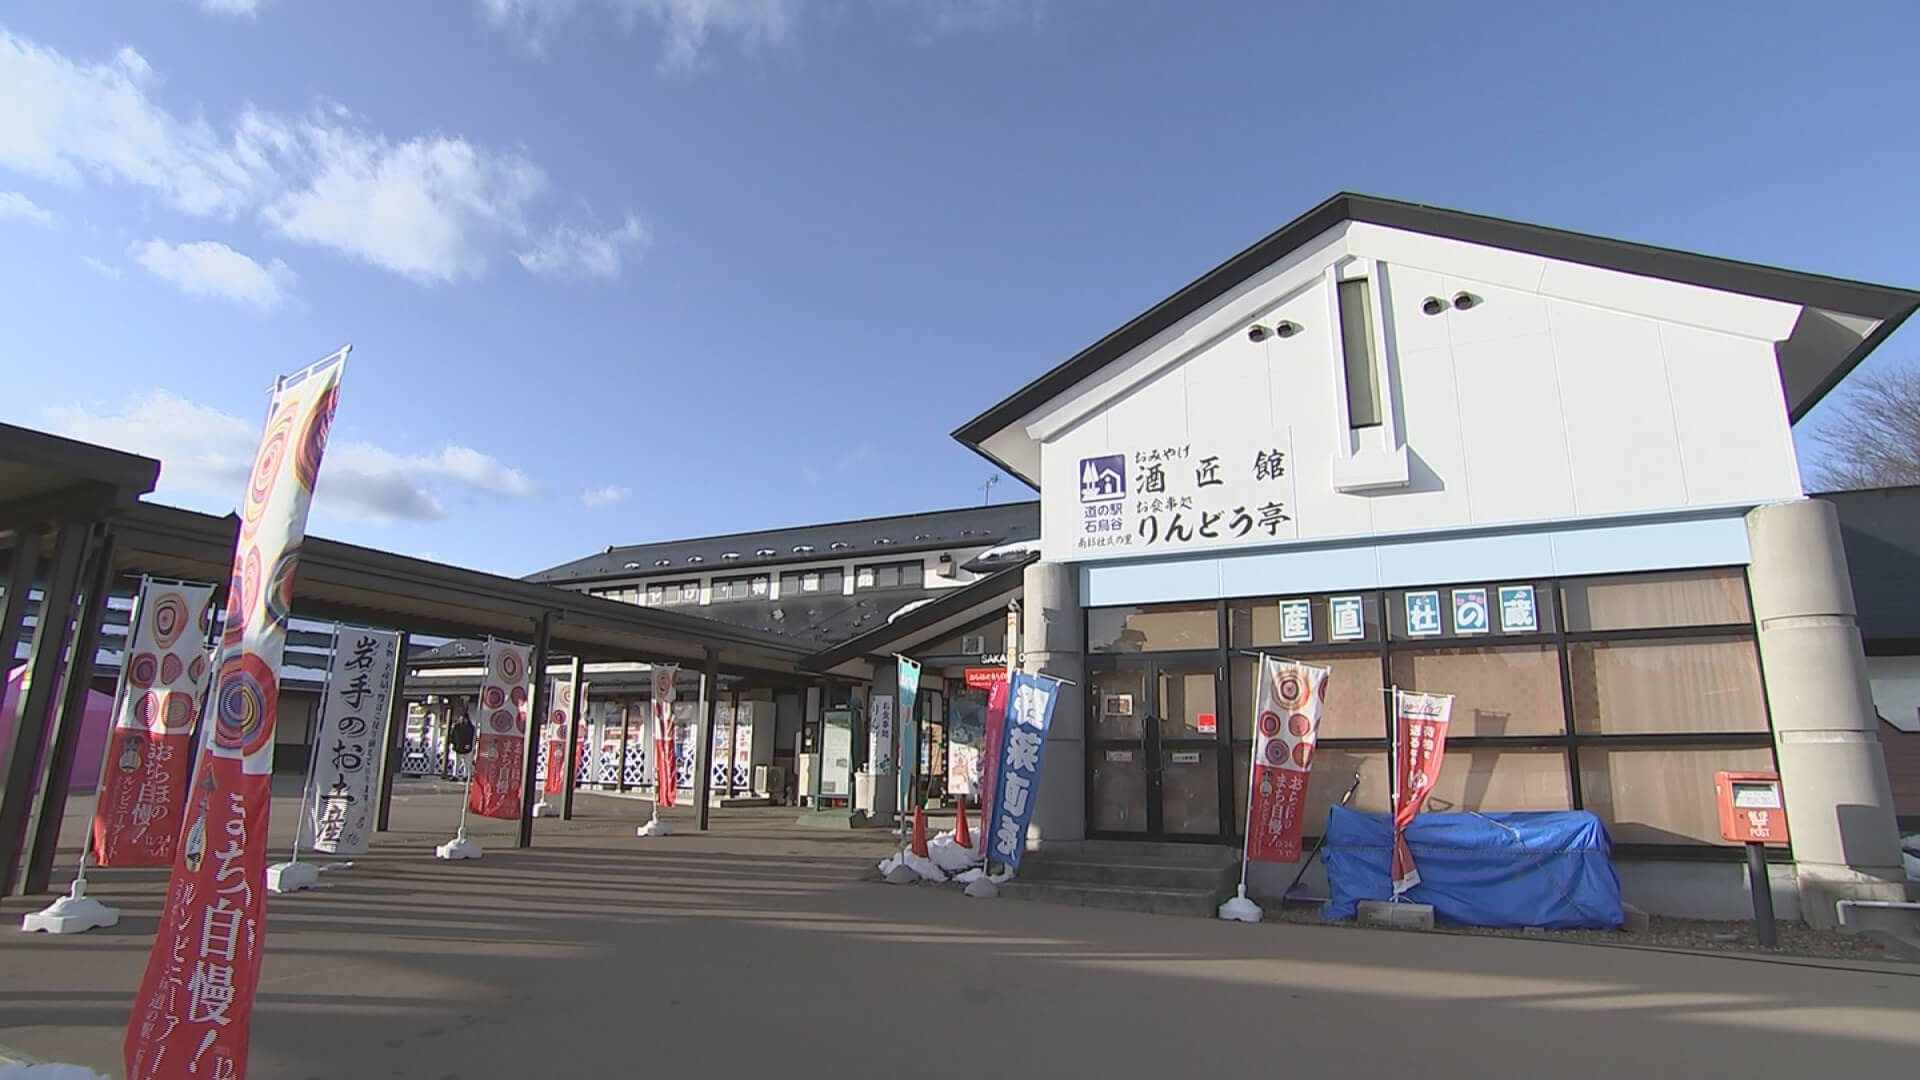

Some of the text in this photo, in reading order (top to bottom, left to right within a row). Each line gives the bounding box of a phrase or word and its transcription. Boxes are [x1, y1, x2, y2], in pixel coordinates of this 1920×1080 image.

[1134, 443, 1191, 464] おみやげ
[1135, 449, 1287, 495] 酒匠館
[1084, 502, 1123, 518] 道の駅
[1136, 496, 1193, 514] お食事処
[1084, 518, 1123, 533] 石鳥谷
[1138, 501, 1291, 545] りんどう亭
[1283, 600, 1361, 638] 産直
[319, 636, 377, 842] 岩手のお土産
[152, 742, 174, 821] おらほの
[1749, 828, 1770, 838] POST
